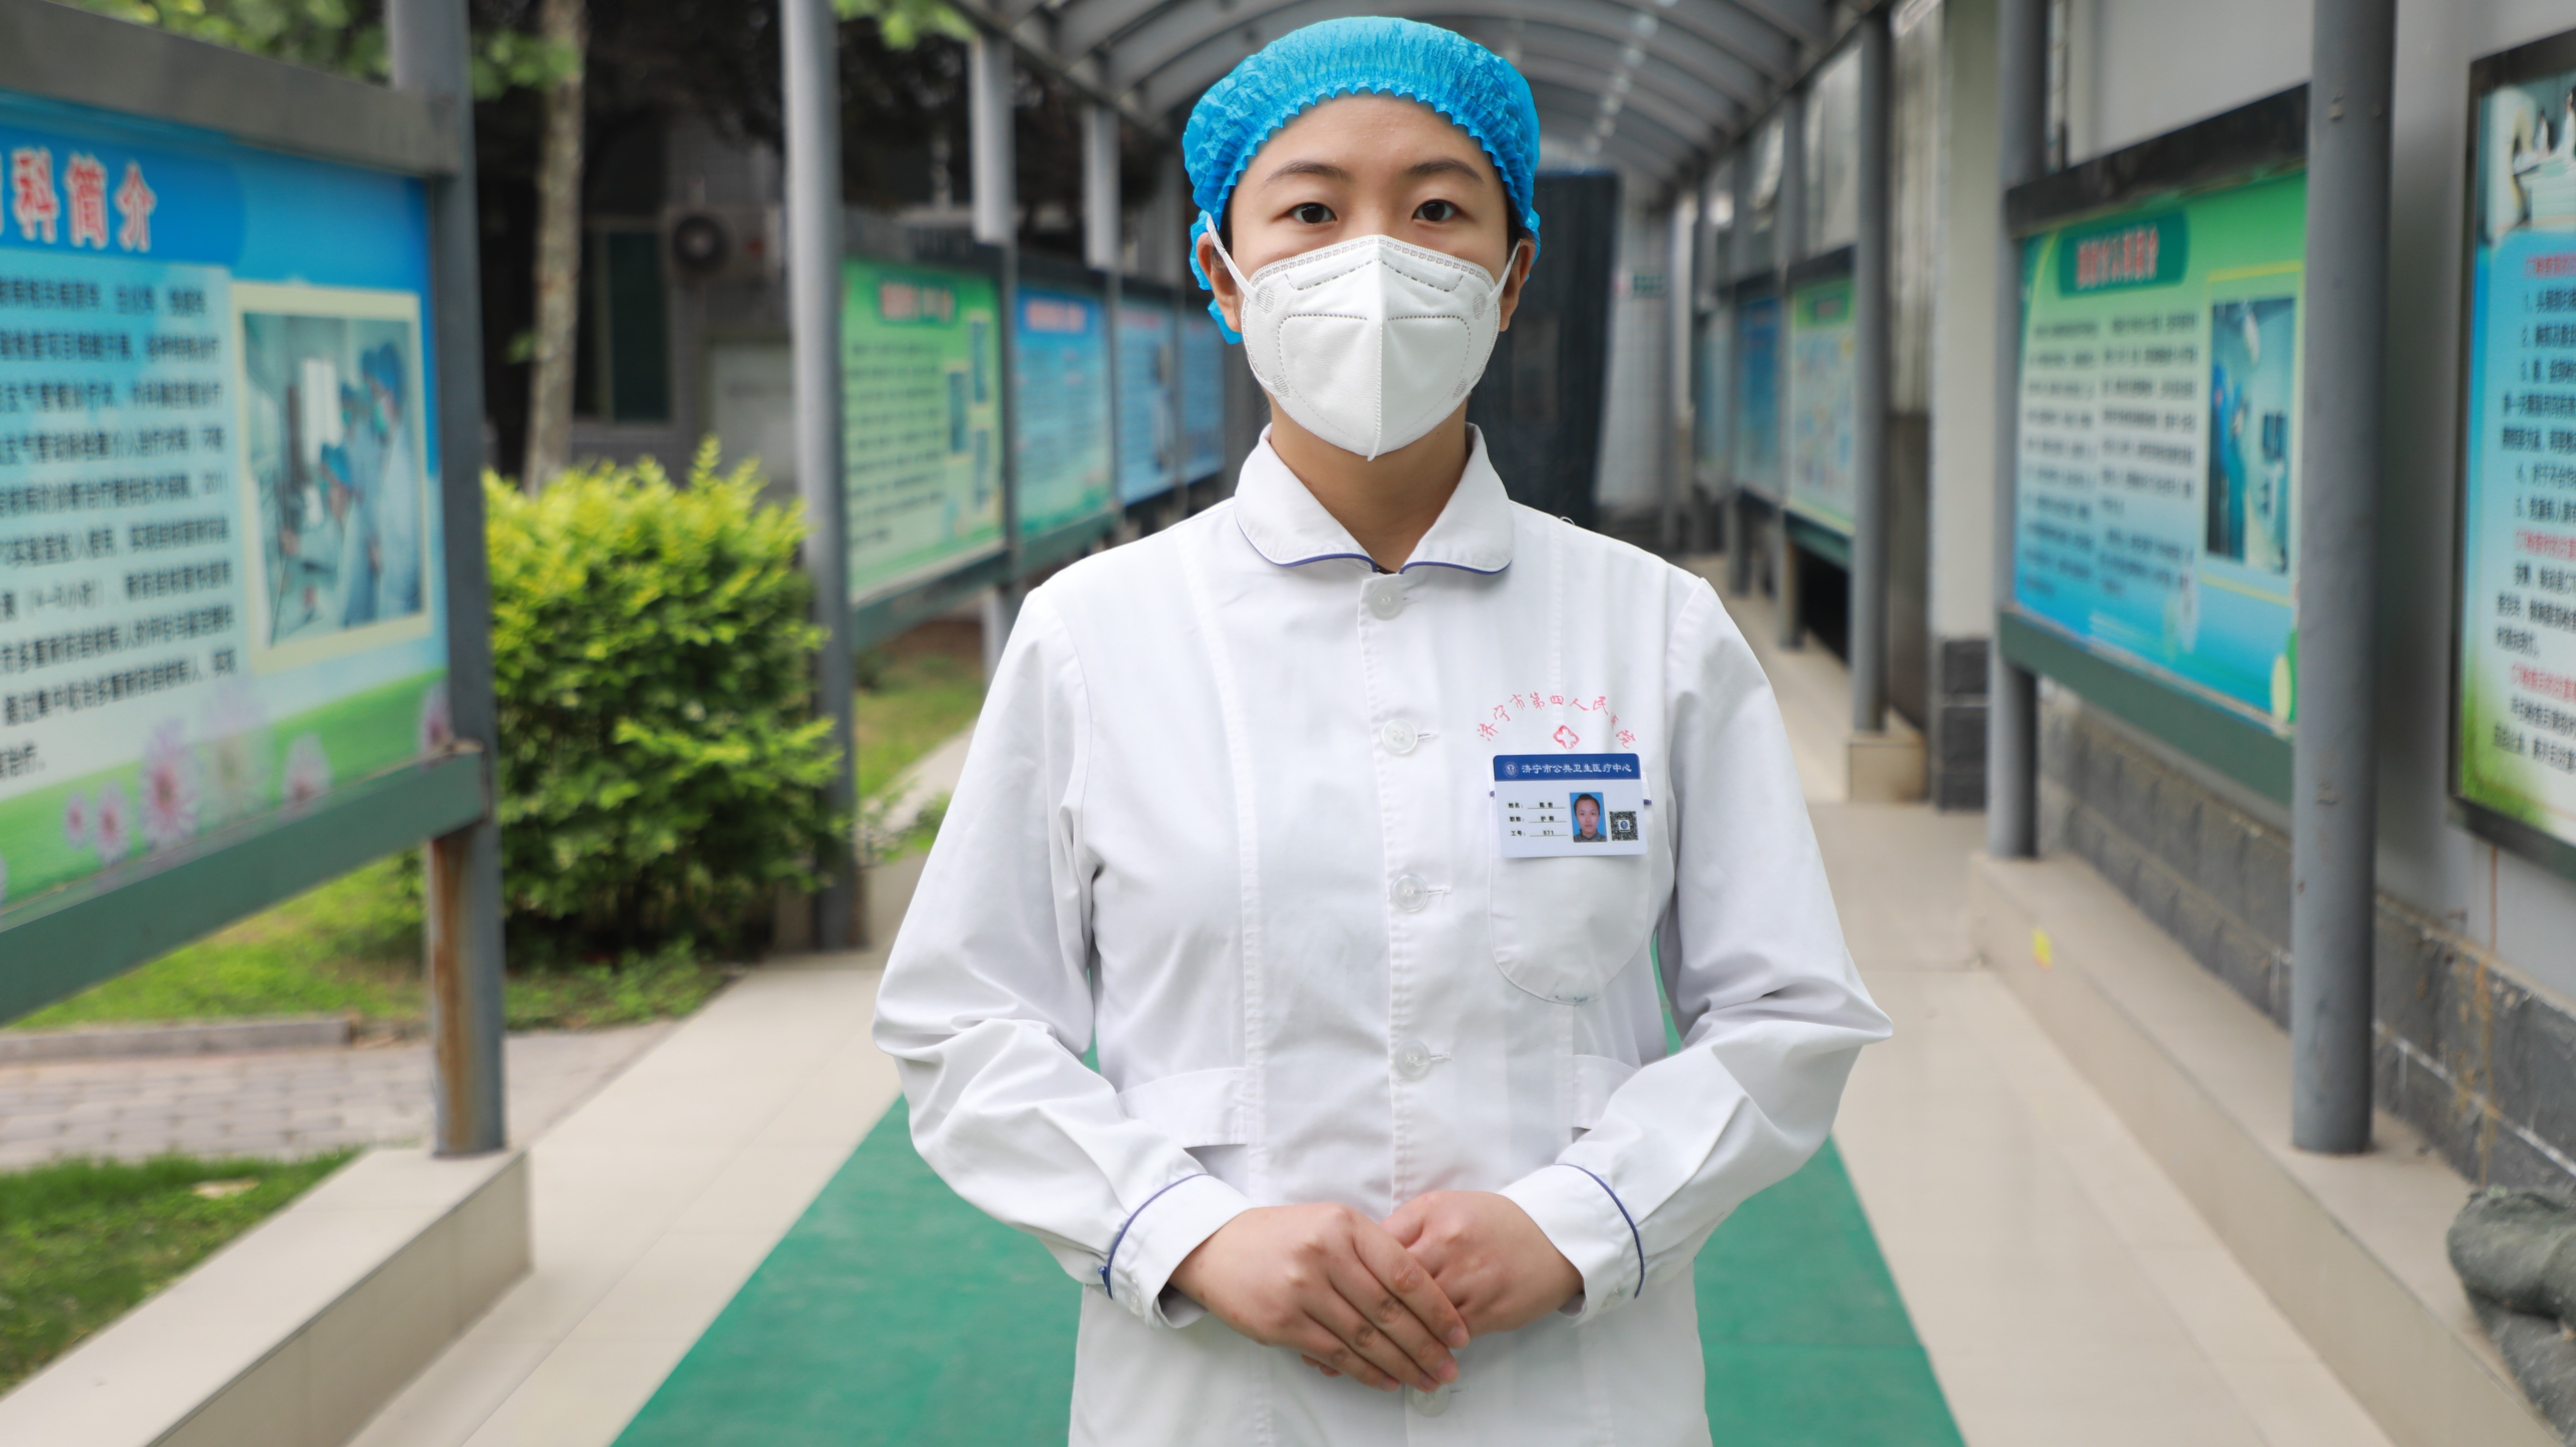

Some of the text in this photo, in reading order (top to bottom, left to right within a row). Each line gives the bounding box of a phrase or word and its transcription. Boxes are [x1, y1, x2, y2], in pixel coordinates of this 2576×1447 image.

[0, 145, 157, 253] 科简介
[1522, 764, 1632, 774] 济宁市公共卫生医疗中心
